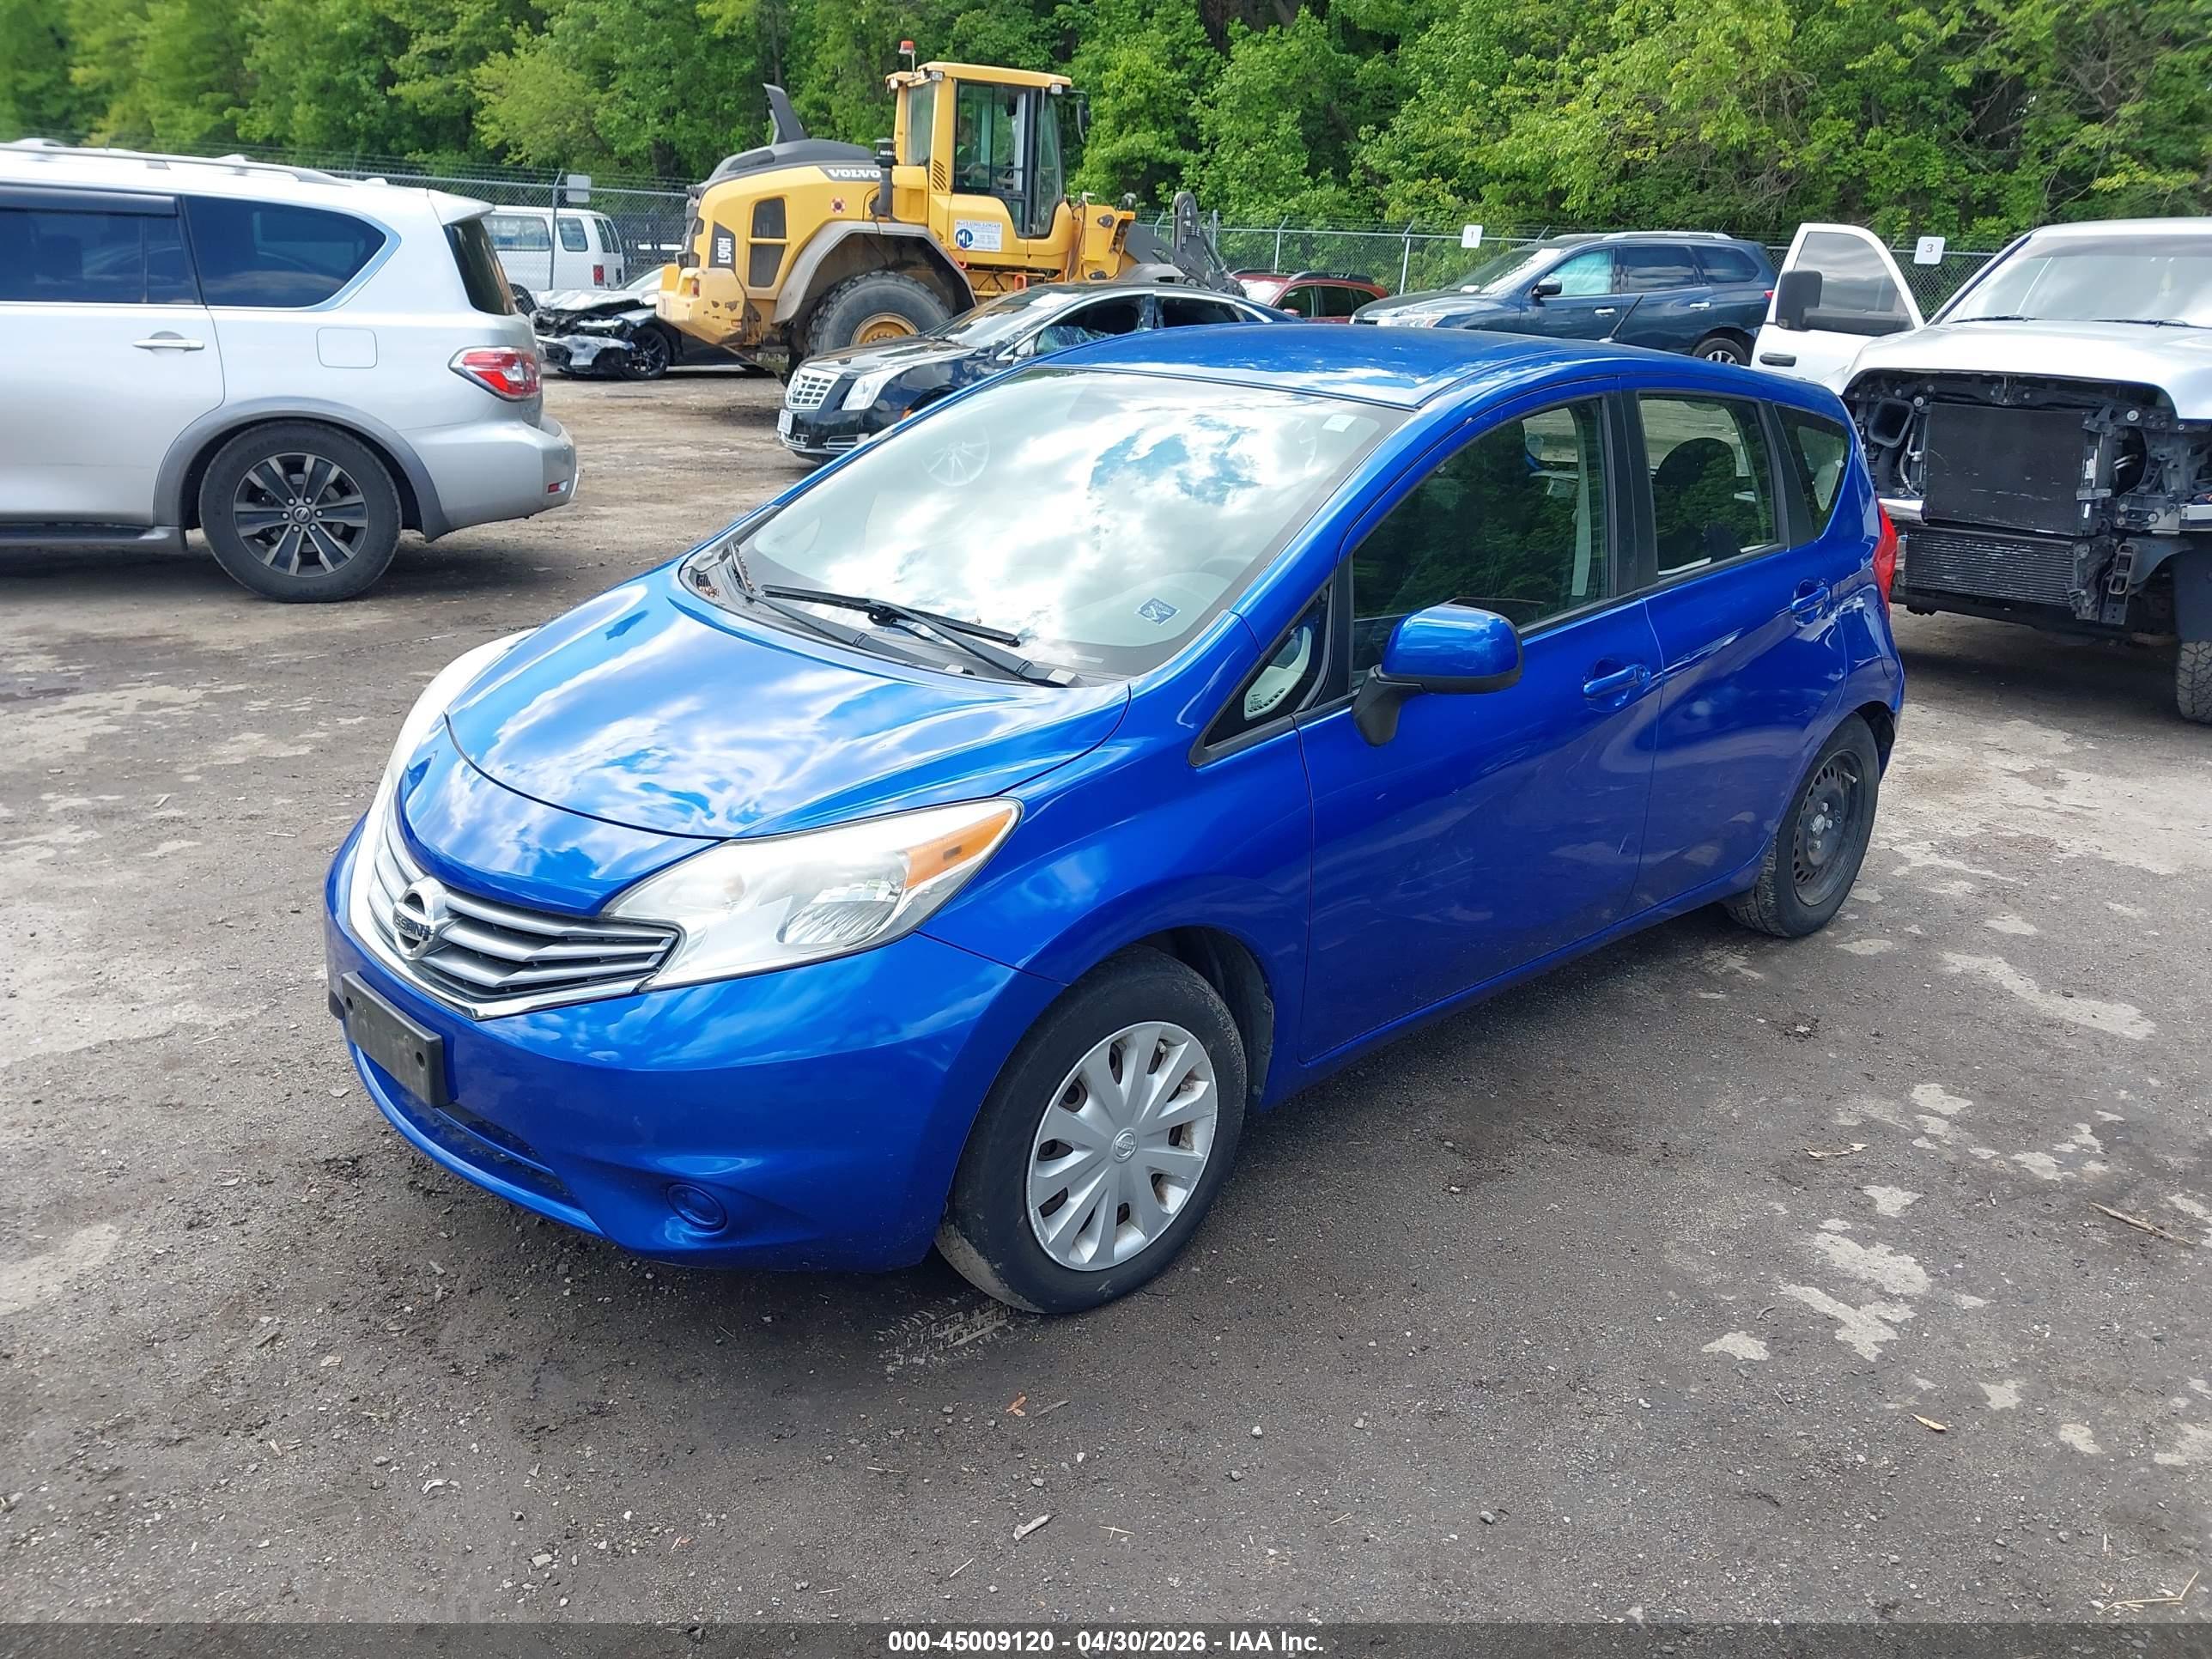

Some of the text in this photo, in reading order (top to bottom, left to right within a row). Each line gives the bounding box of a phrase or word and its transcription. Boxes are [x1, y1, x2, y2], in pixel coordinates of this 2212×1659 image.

[827, 168, 882, 179] VOLVO
[957, 231, 973, 247] ML
[717, 237, 732, 264] L90H
[1925, 243, 1934, 252] 3
[394, 912, 424, 937] ISSAN
